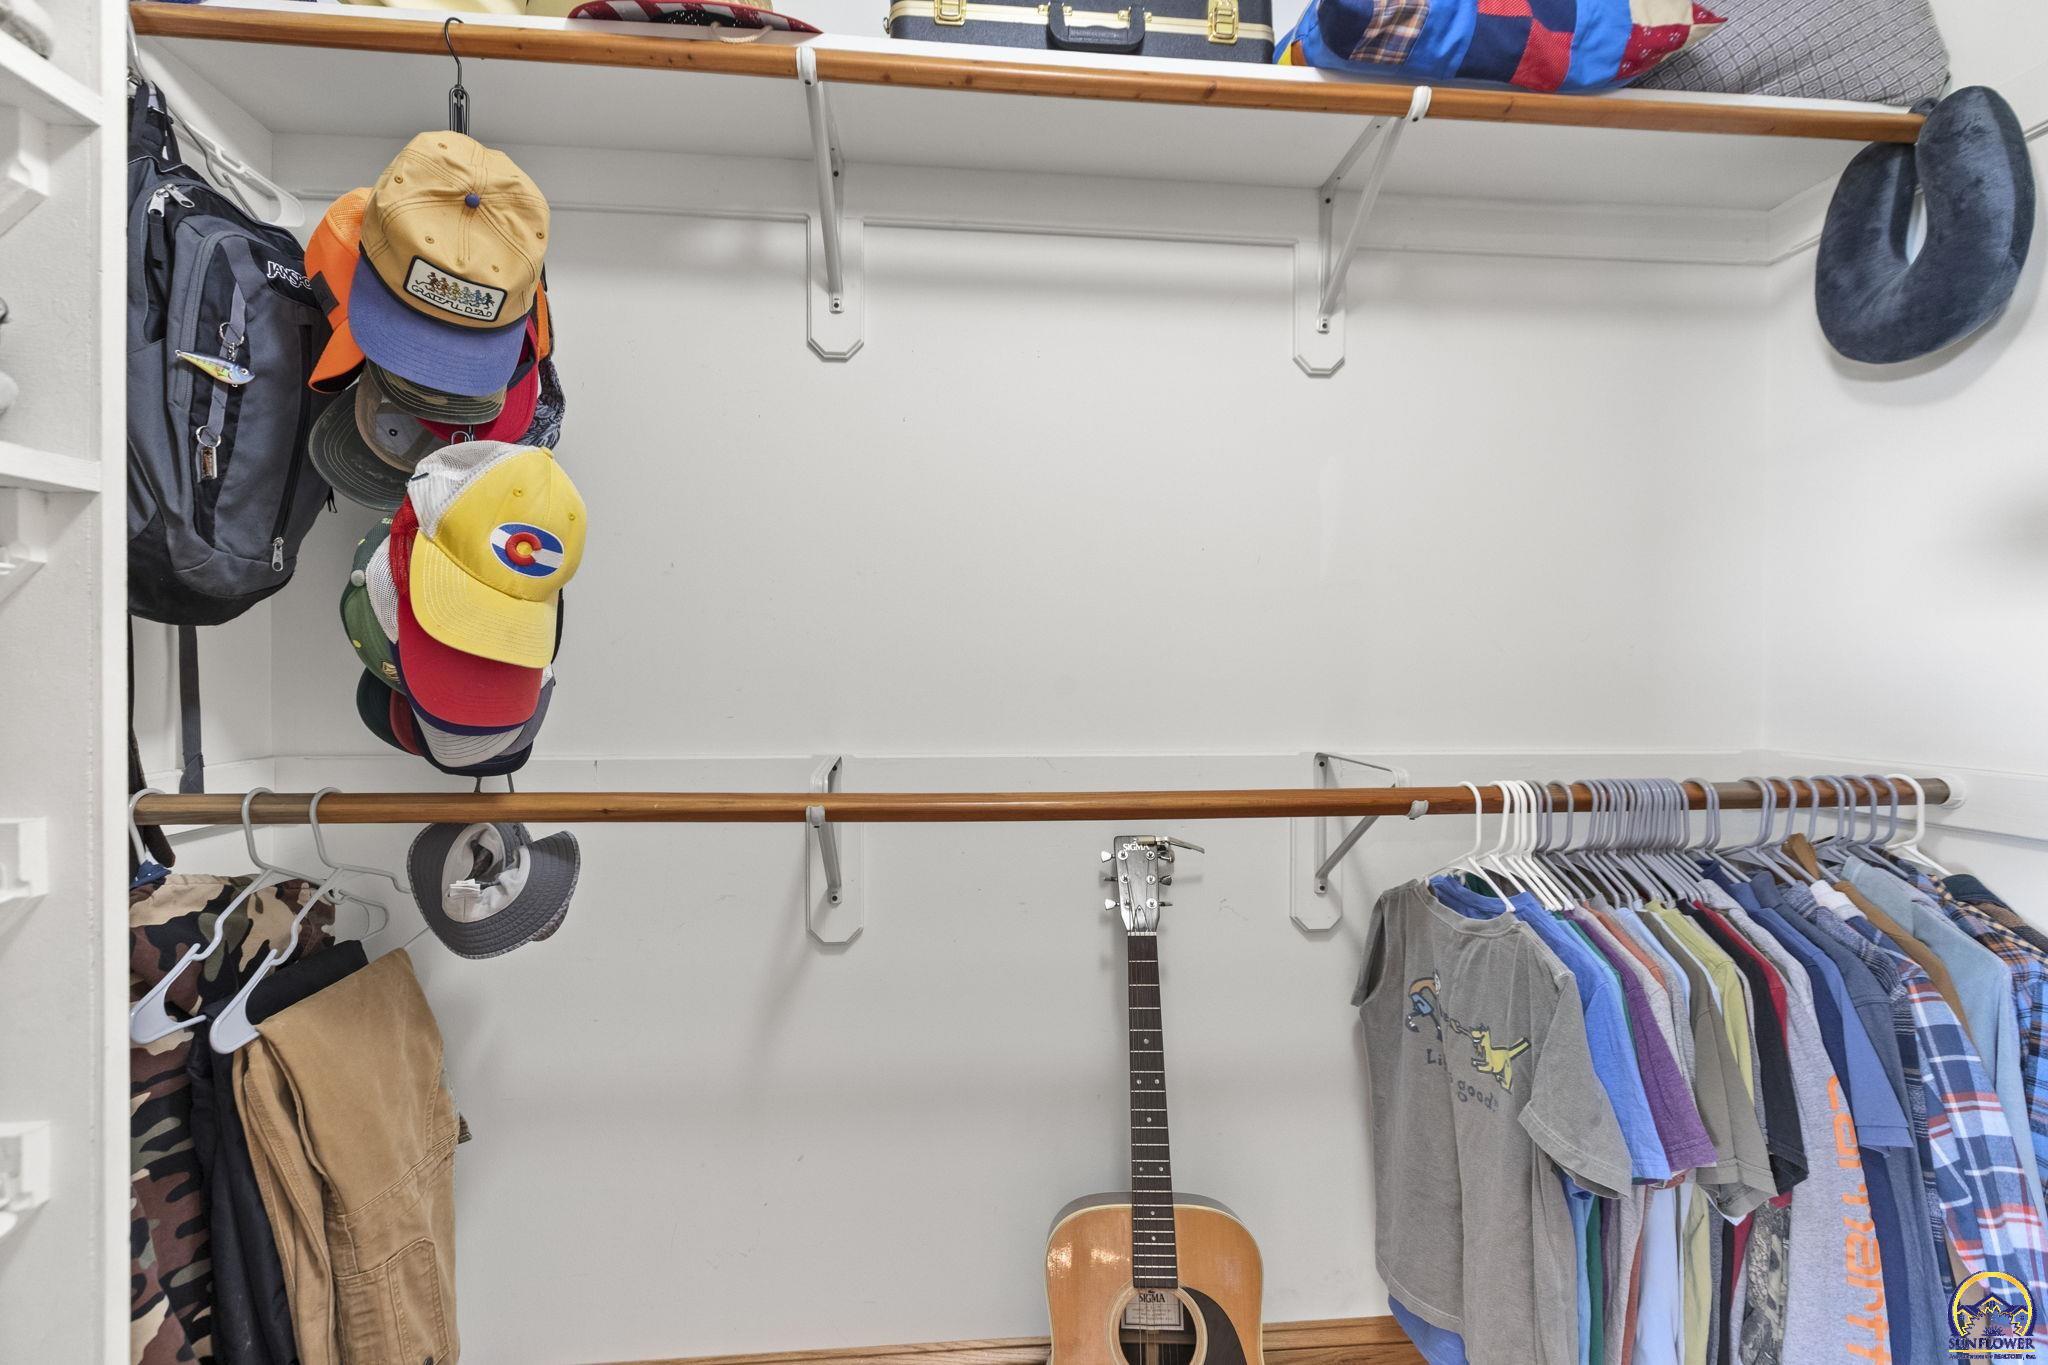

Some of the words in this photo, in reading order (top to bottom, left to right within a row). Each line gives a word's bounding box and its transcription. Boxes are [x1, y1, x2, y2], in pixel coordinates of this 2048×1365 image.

[267, 260, 313, 290] JANSPO
[411, 284, 463, 312] GRATEFUL
[1139, 1292, 1166, 1303] SIGMA
